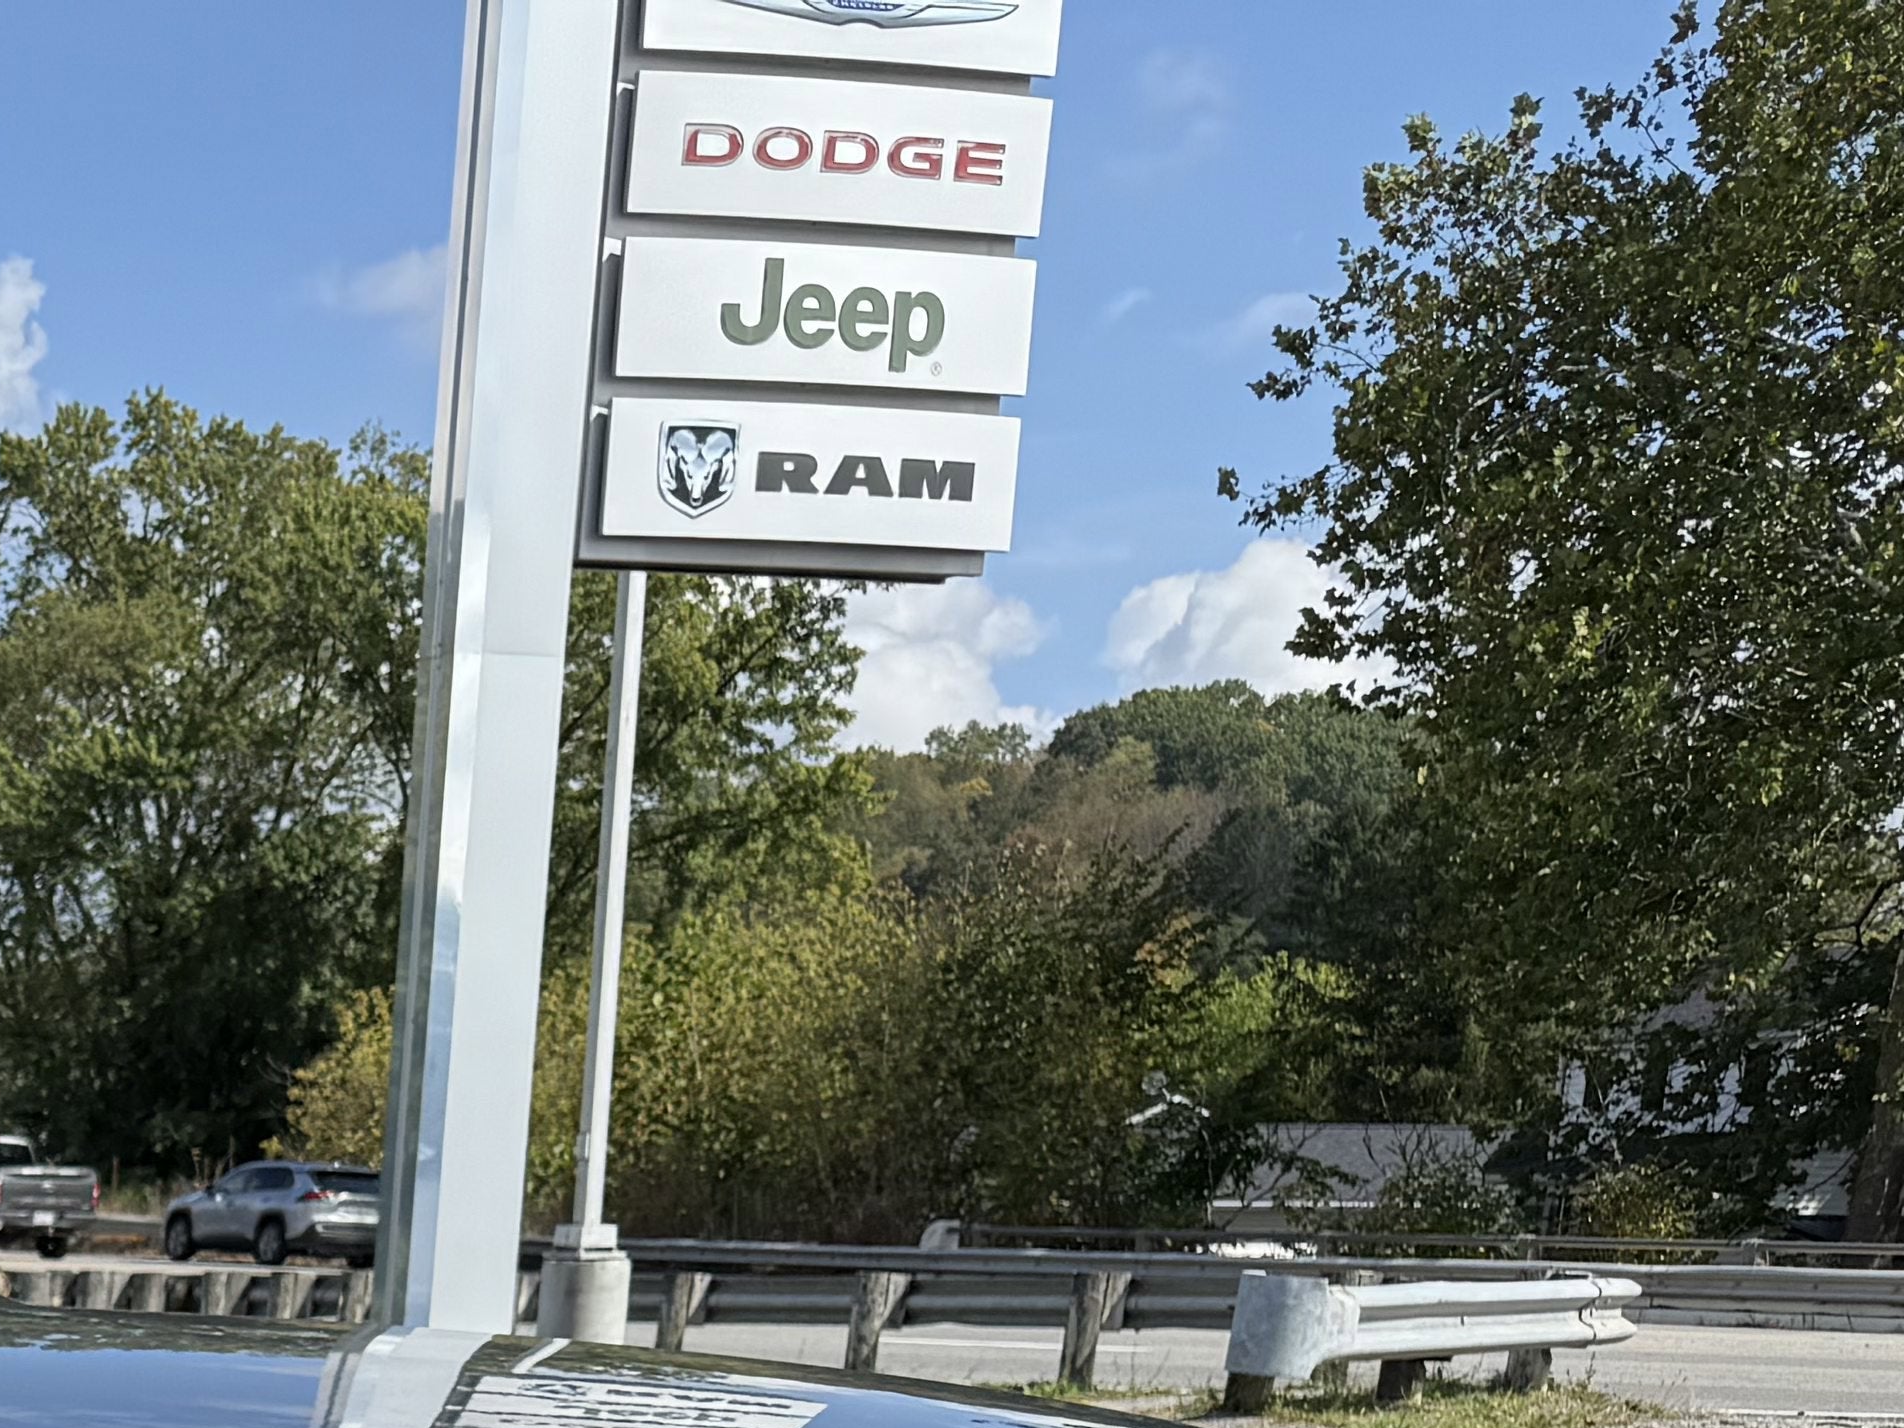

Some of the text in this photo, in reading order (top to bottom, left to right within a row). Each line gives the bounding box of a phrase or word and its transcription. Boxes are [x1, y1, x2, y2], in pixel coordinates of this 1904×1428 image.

[681, 123, 1006, 186] DODGE
[720, 257, 945, 373] Jeep
[755, 451, 975, 502] RAM
